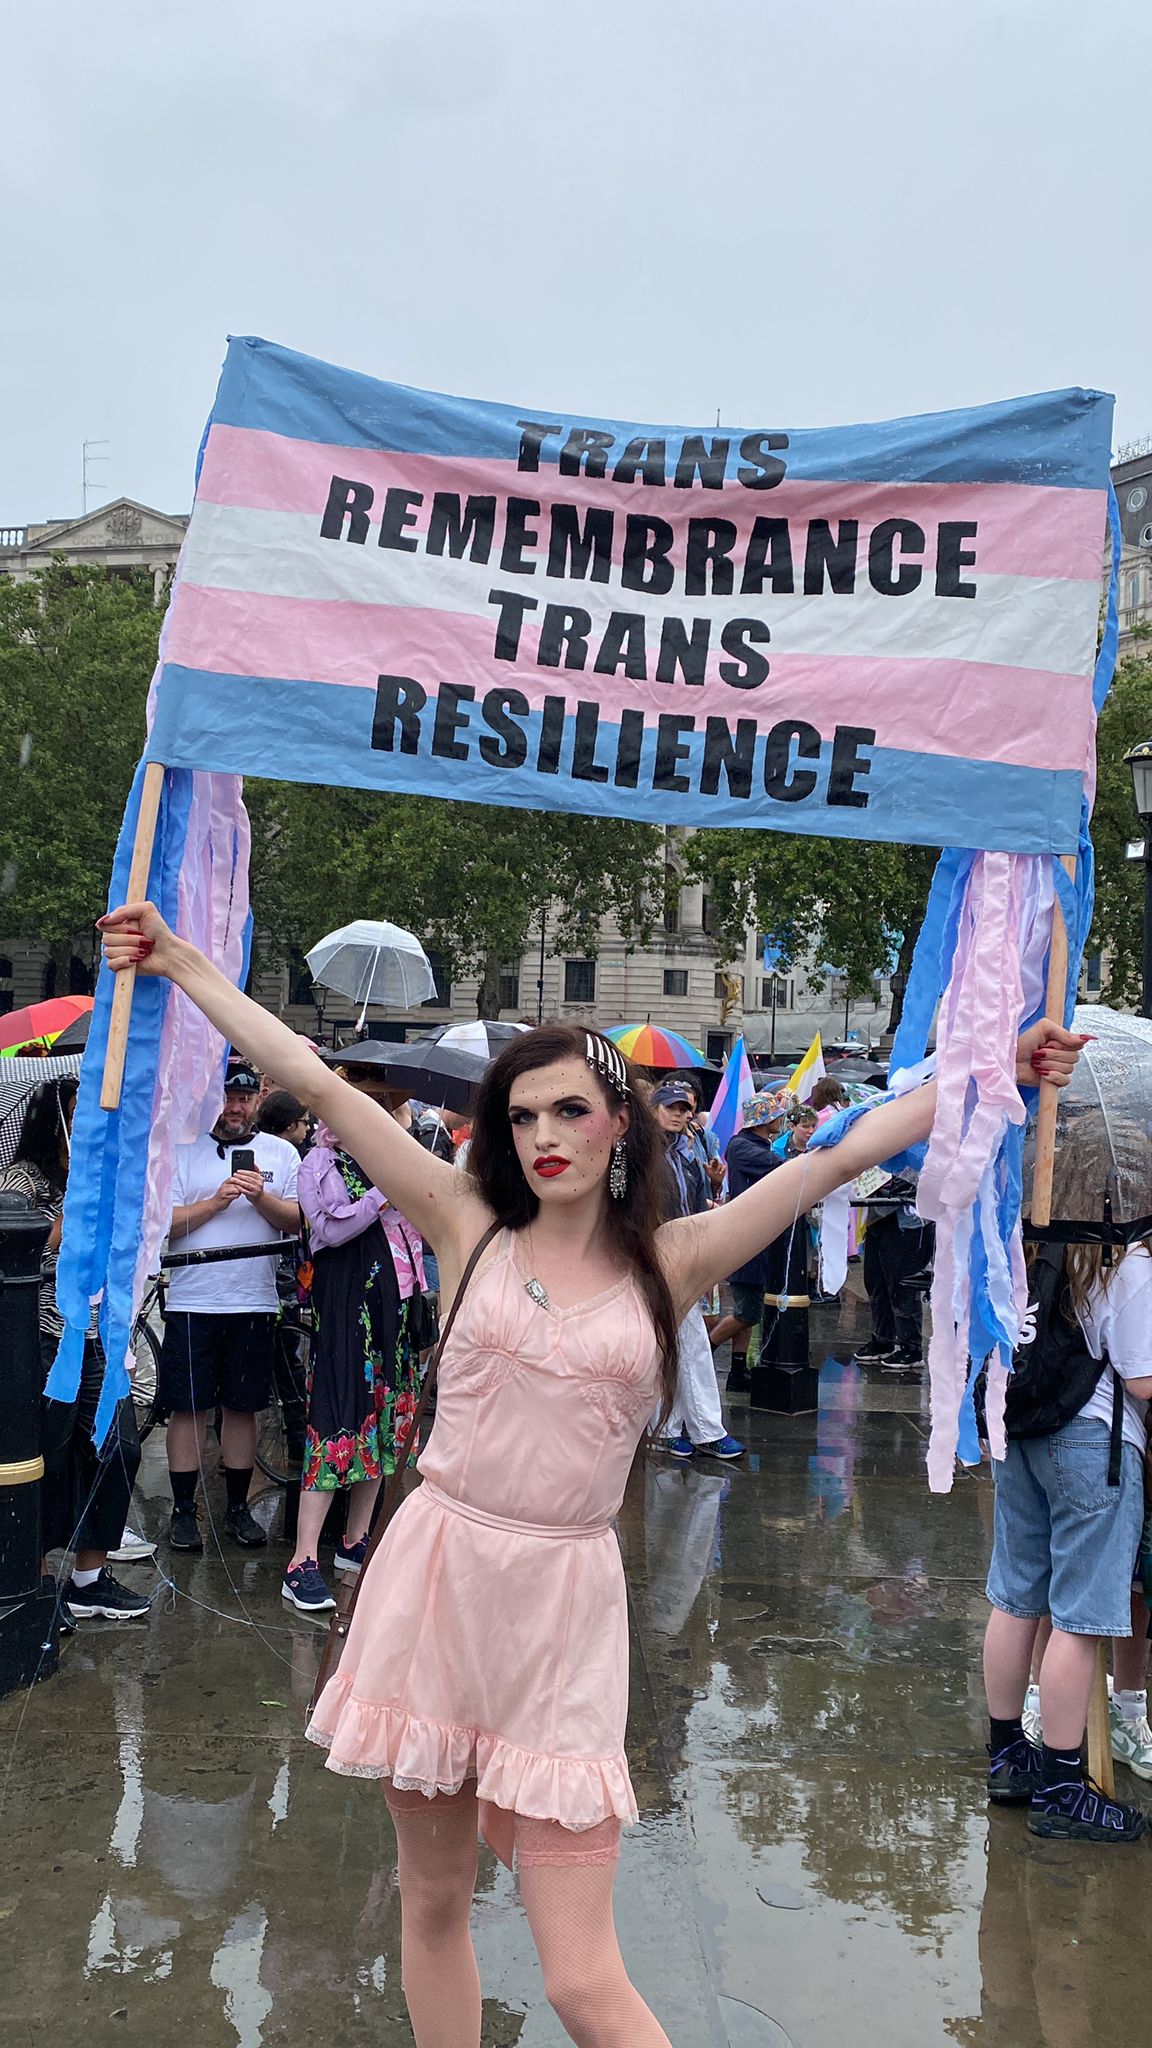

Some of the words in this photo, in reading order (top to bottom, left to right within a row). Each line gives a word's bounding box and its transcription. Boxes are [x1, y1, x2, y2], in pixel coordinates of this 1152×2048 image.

[516, 420, 789, 490] TRANS
[320, 475, 978, 598] REMEMBRANCE
[489, 589, 771, 689] TRANS
[371, 674, 876, 807] RESILIENCE
